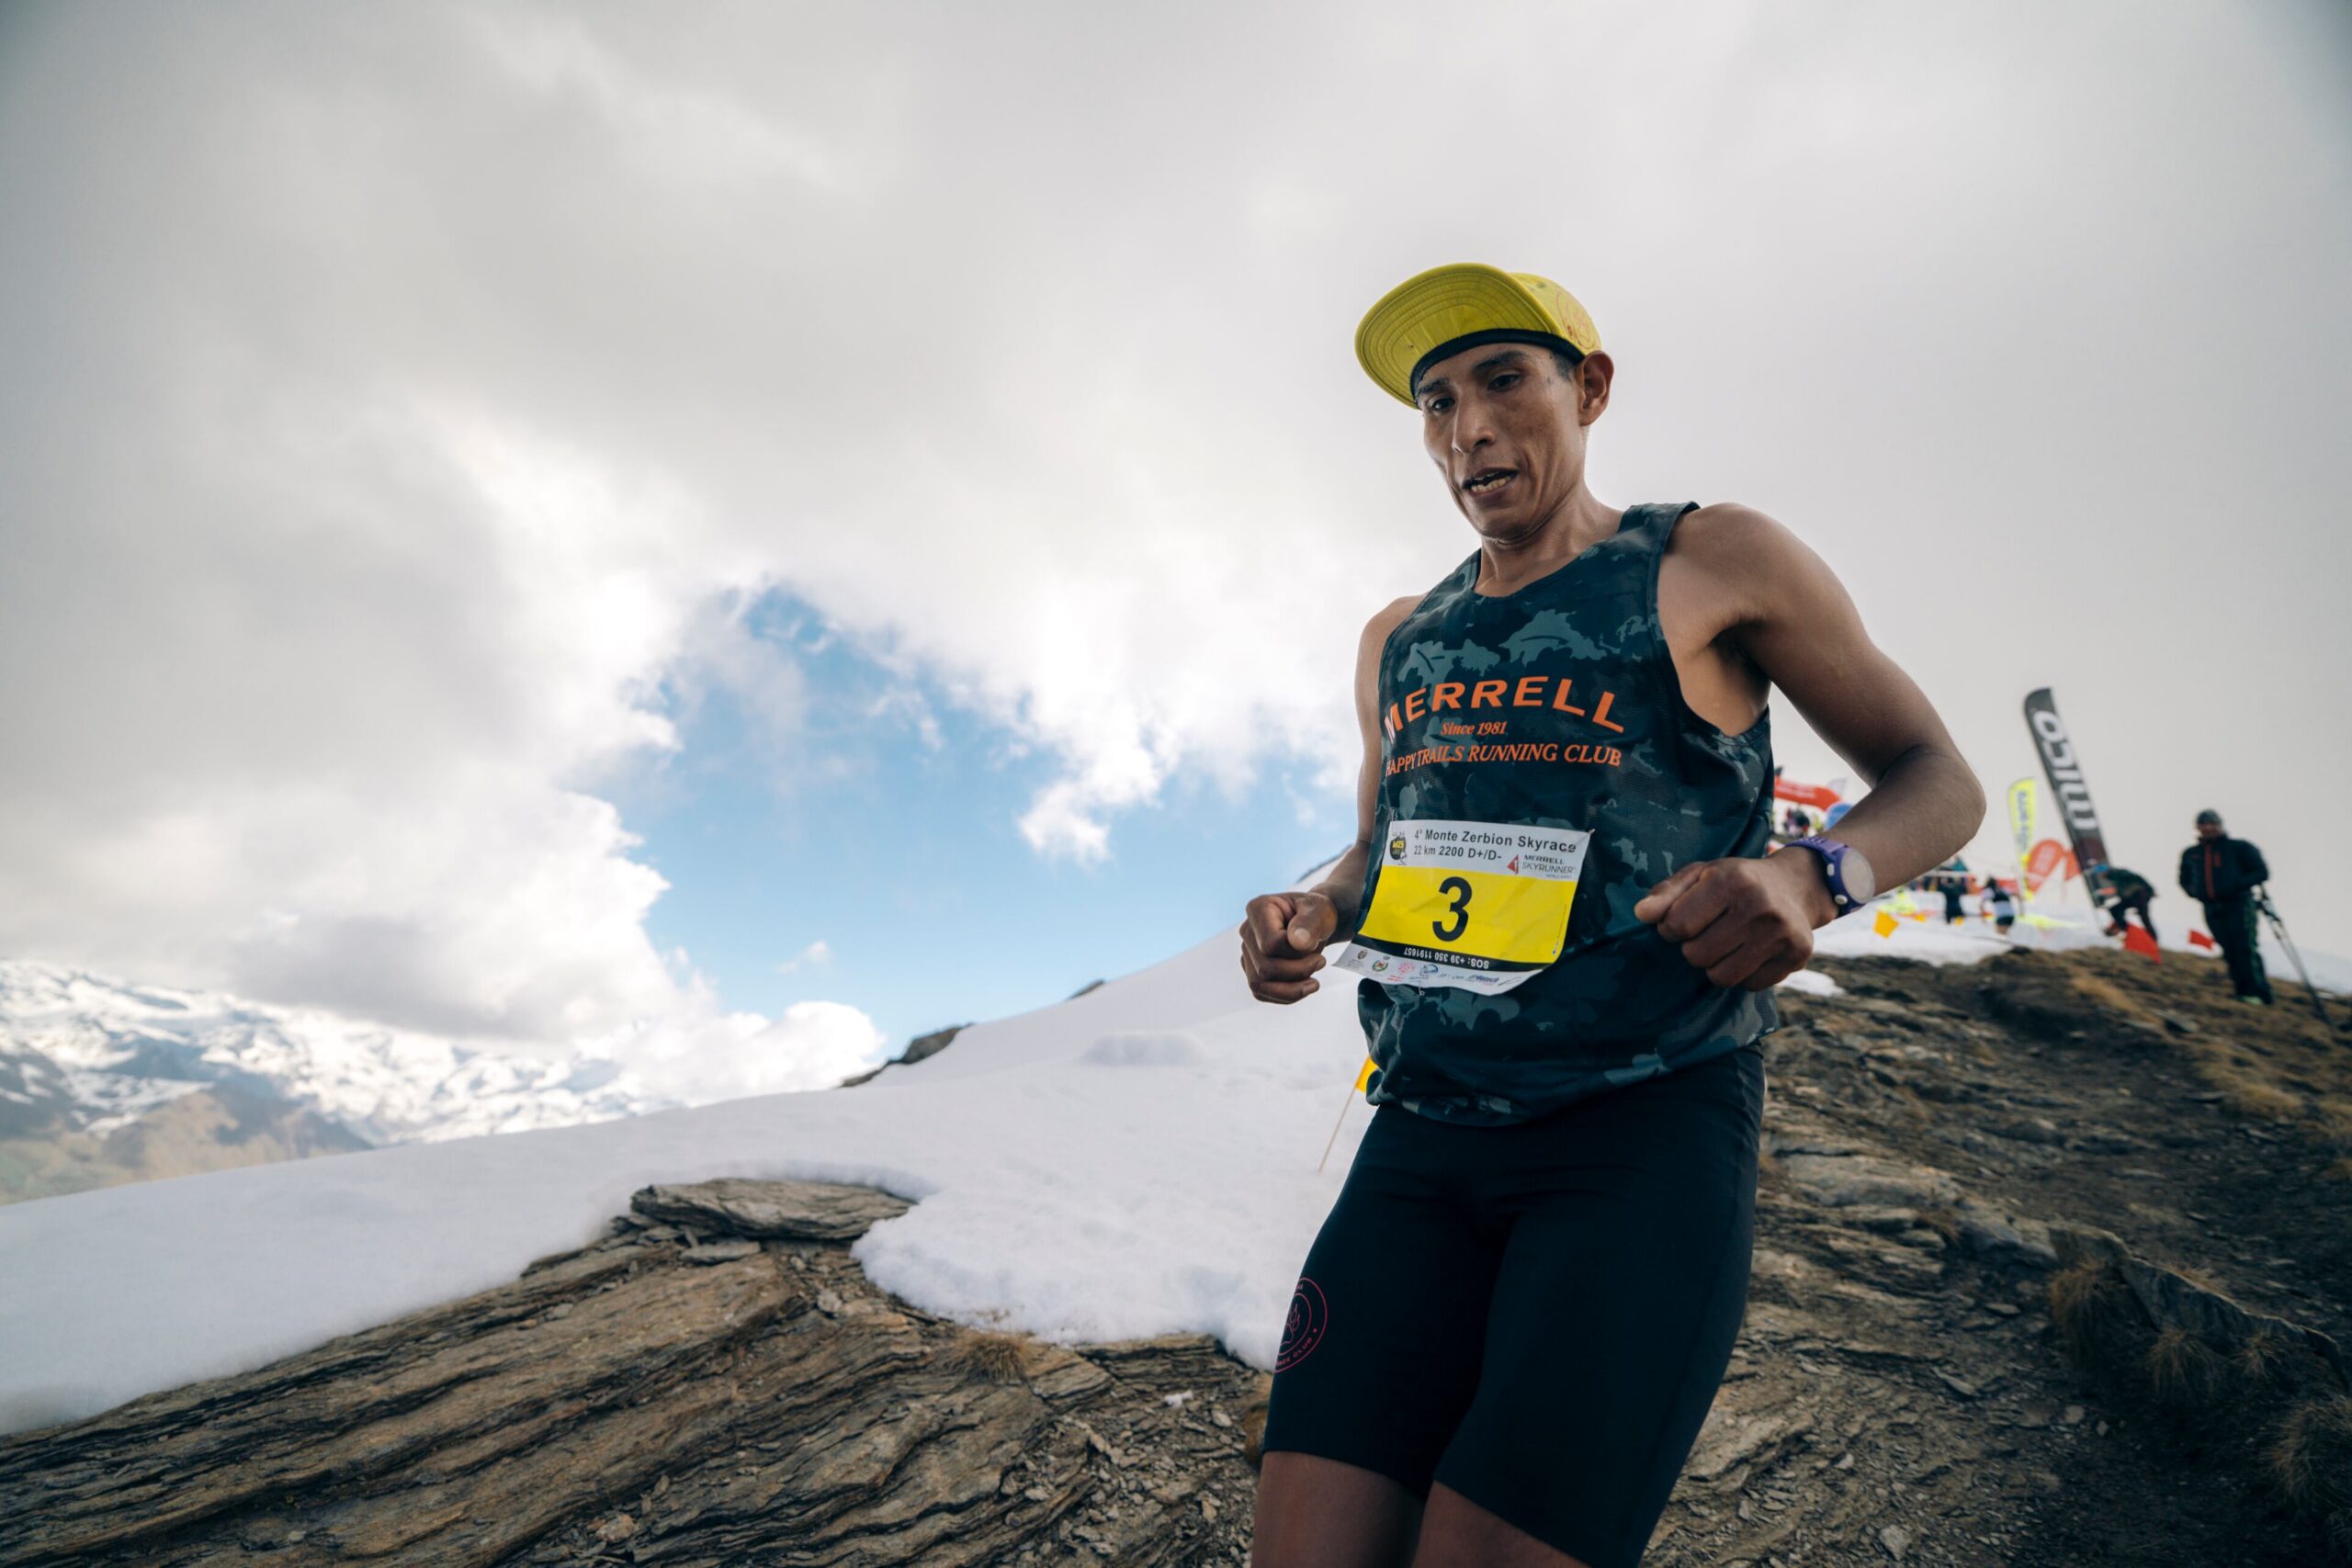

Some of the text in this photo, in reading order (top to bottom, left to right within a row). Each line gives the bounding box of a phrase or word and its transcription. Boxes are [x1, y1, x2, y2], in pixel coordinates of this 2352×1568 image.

[1384, 675, 1625, 746] MERRELL
[1440, 721, 1508, 736] Since 1981
[1417, 745, 1465, 768] TRAILS
[1467, 743, 1559, 763] RUNNING
[1564, 744, 1622, 767] CLUB
[1425, 829, 1458, 842] Monte
[1462, 830, 1512, 846] Zerbion
[1518, 835, 1577, 853] Skyrace
[1413, 845, 1423, 855] 22
[1424, 845, 1436, 855] km
[1439, 845, 1464, 857] 2200
[1467, 848, 1502, 862] D+/D-
[1523, 854, 1564, 864] MERRELL
[1432, 876, 1473, 942] 3
[1434, 952, 1449, 963] 350
[1450, 954, 1465, 964] +39
[1467, 957, 1490, 970] SOS:
